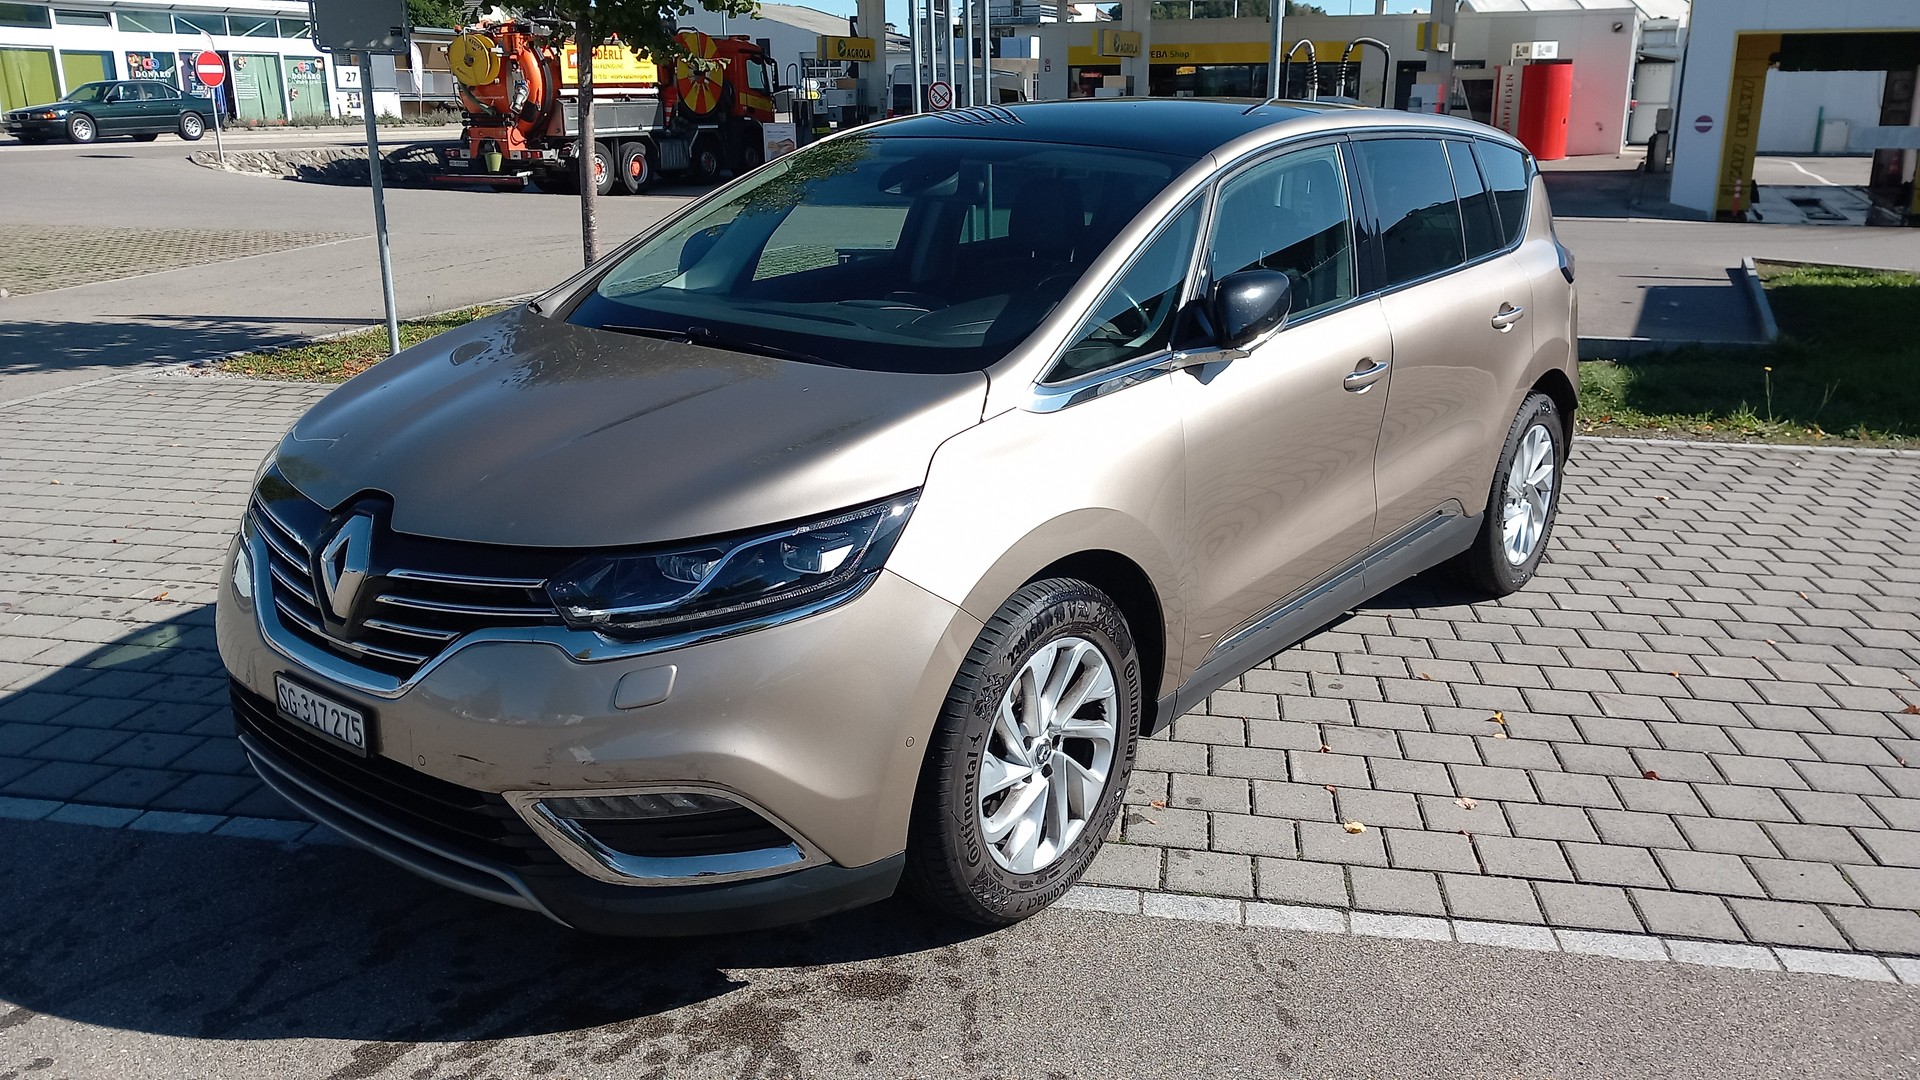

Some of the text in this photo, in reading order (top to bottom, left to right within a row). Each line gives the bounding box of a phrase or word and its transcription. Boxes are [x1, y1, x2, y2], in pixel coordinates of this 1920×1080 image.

[846, 48, 871, 58] AGROLA
[1120, 43, 1138, 54] AGROLA
[594, 49, 623, 60] DERLI
[1149, 50, 1190, 59] EBA Shop
[135, 70, 171, 78] DONARO
[346, 71, 357, 82] 27
[1124, 659, 1139, 762] Continental
[960, 751, 981, 868] Continental
[1027, 834, 1104, 911] PremiumContact
